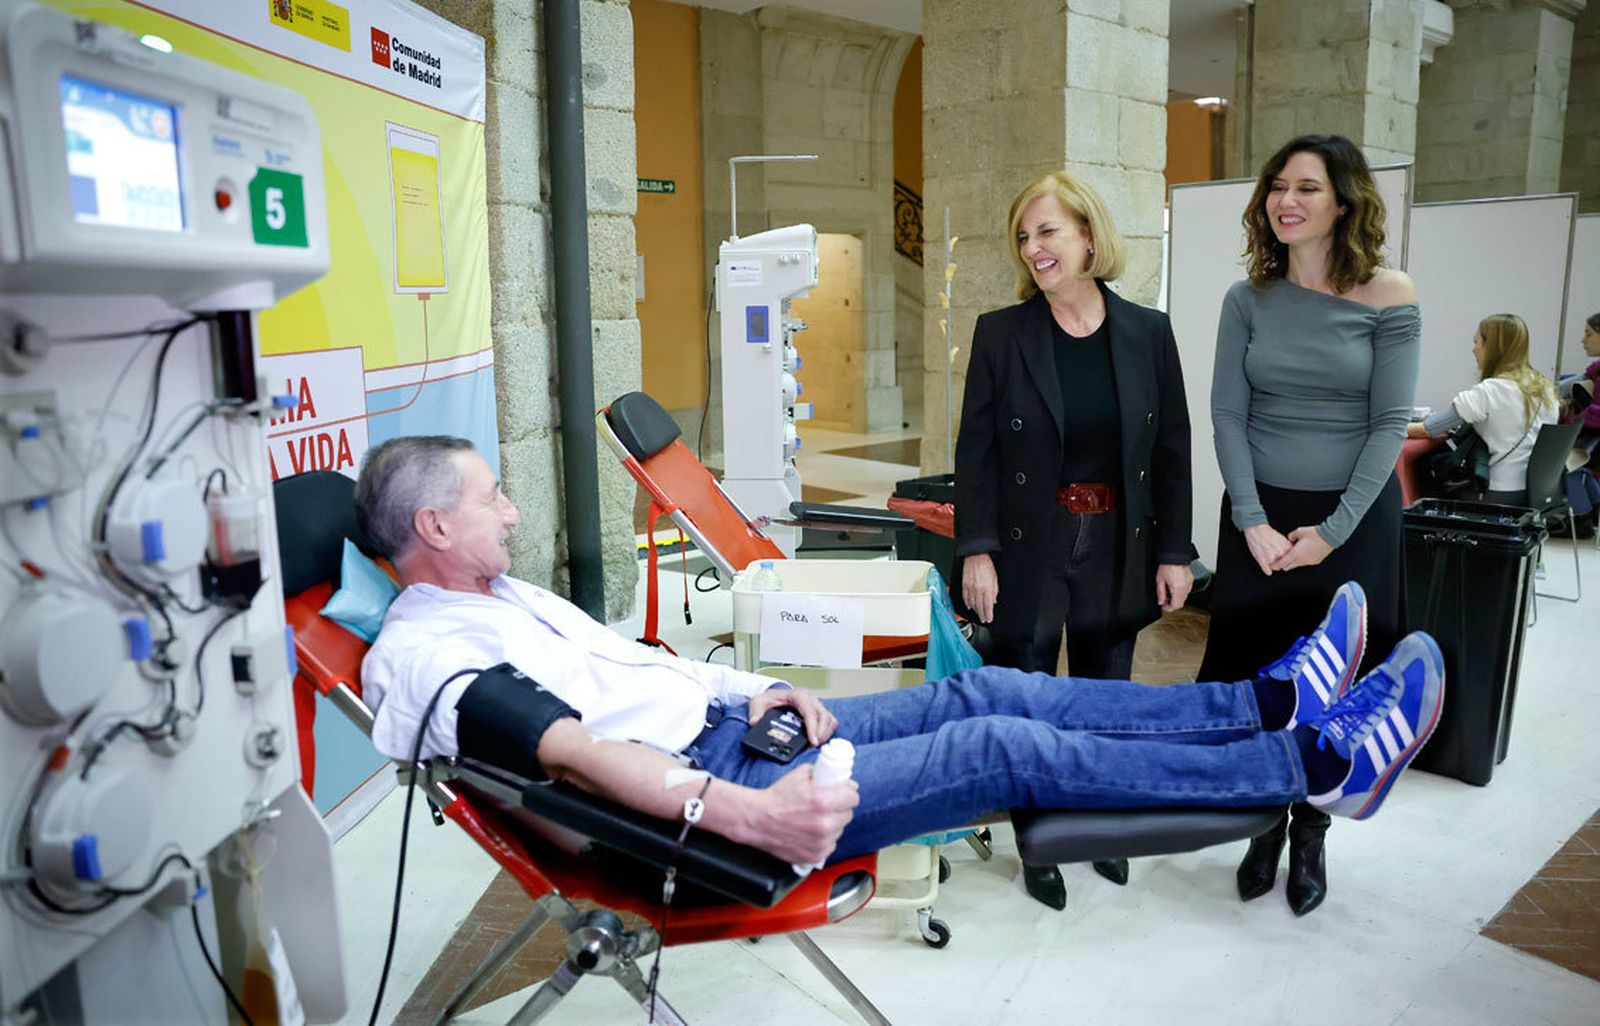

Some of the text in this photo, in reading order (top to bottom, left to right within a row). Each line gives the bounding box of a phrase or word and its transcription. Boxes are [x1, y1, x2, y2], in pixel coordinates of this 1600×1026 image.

[392, 37, 441, 70] Comunidad
[393, 57, 441, 88] de Madrid
[265, 187, 286, 230] 5
[287, 428, 354, 476] VIDA
[780, 610, 808, 623] PARA
